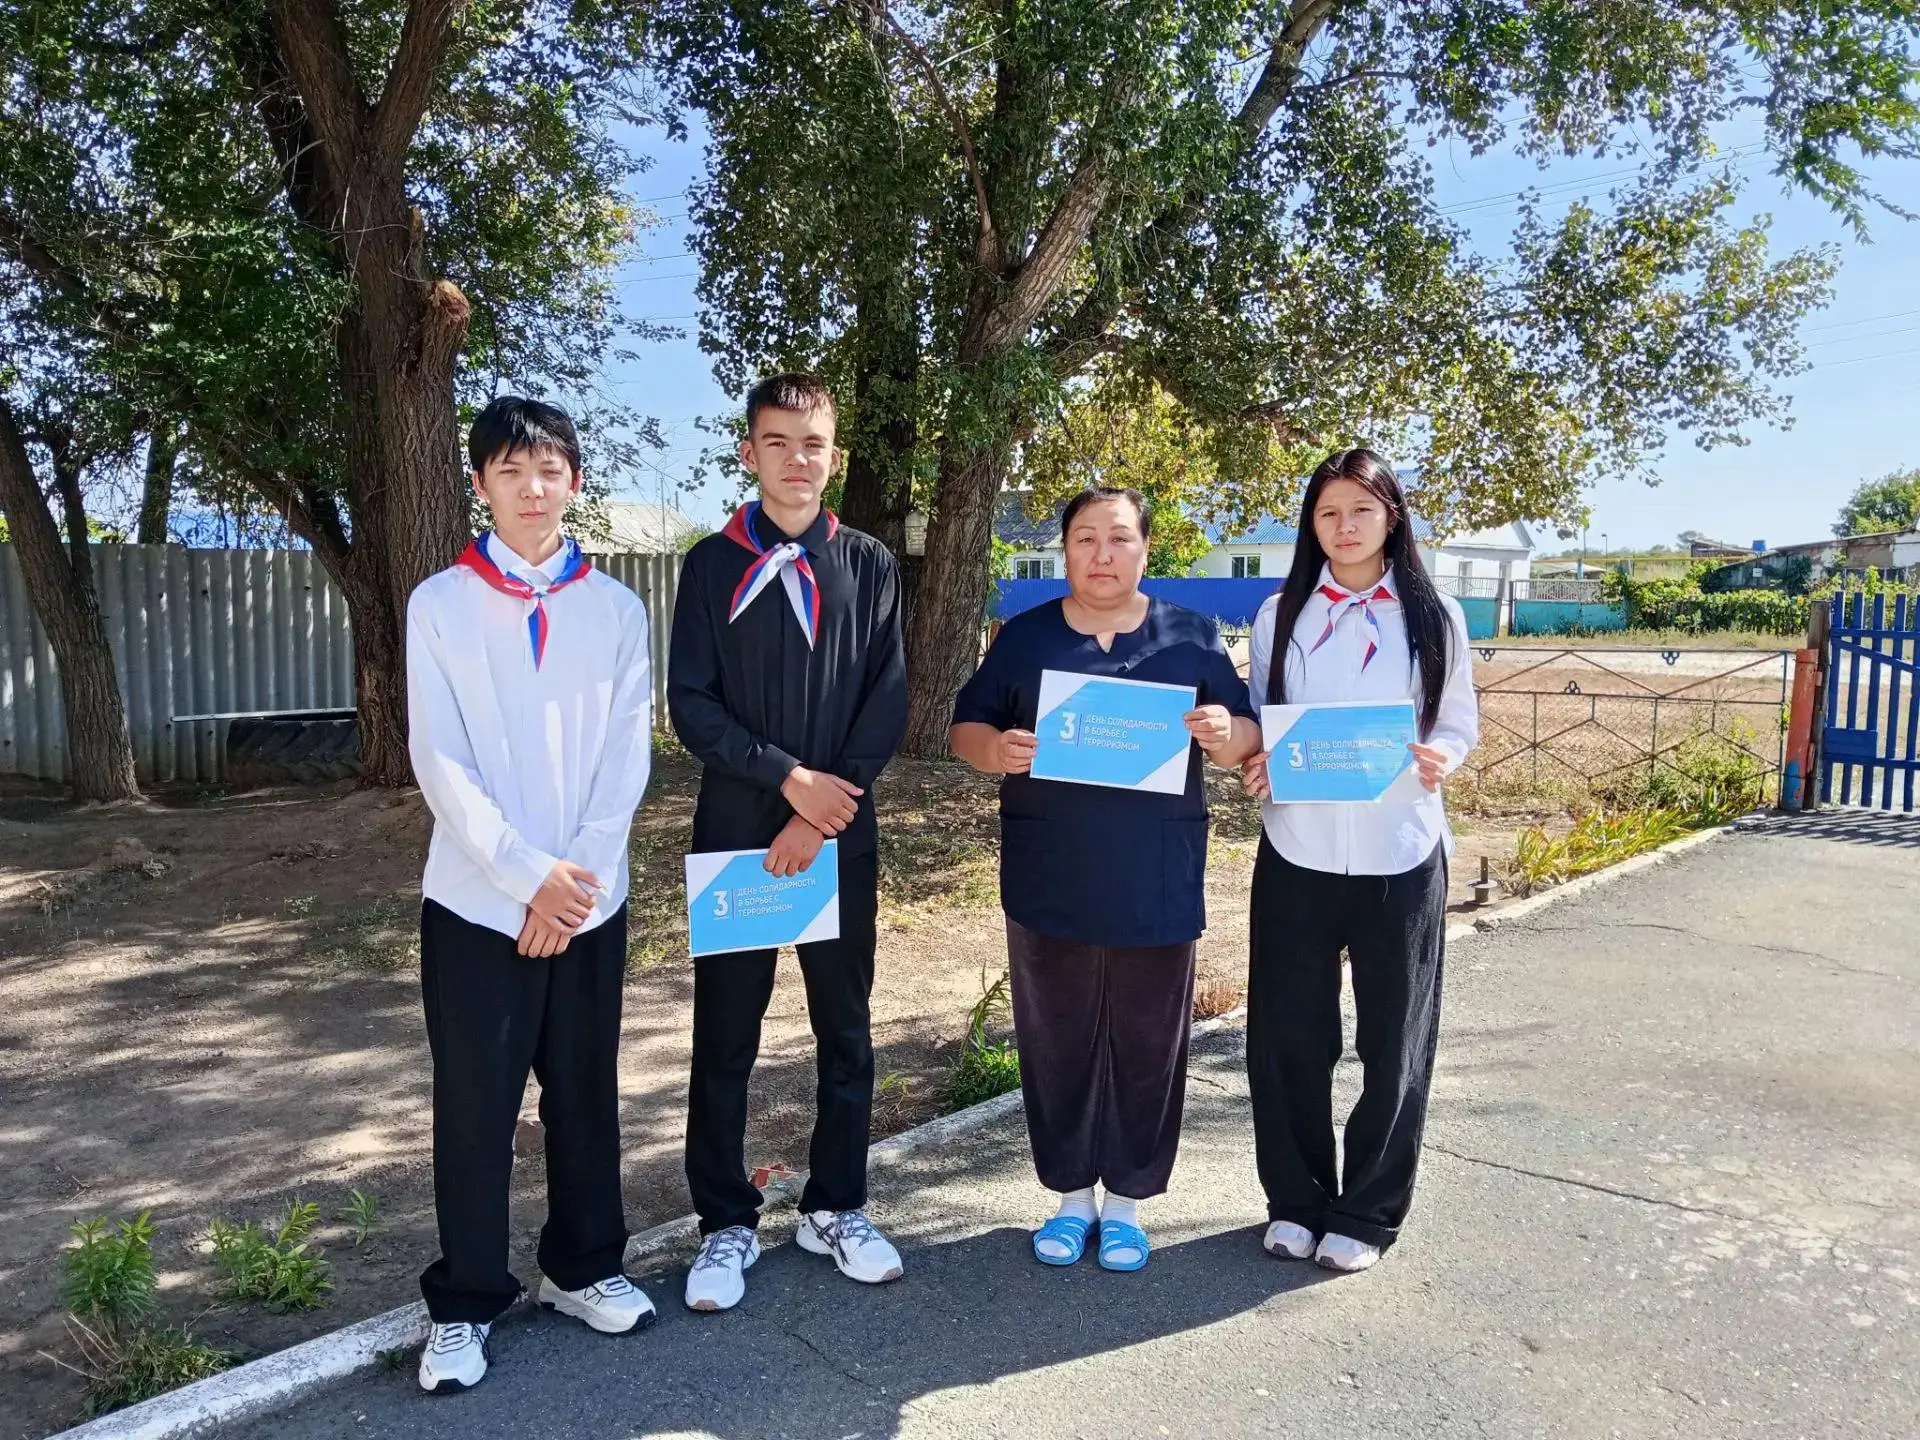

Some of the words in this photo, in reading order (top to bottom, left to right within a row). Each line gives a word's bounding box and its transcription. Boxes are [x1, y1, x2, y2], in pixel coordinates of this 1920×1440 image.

[1060, 711, 1076, 739] 3
[1085, 714, 1106, 724] ДЕНЬ
[1107, 717, 1168, 731] СОЛИДАРНОСТИ
[1092, 727, 1120, 737] БОРЬБЕ
[1122, 730, 1128, 739] С
[1084, 738, 1140, 752] ТЕРРОРИЗМОМ
[1311, 741, 1331, 749] ДЕНЬ
[1288, 742, 1304, 768] 3
[1318, 752, 1347, 760] БОРЬБЕ
[737, 888, 758, 896] ДЕНЬ
[759, 878, 816, 893] СОЛИДАРНОСТИ
[713, 890, 728, 917] 3
[738, 899, 743, 907] В
[745, 896, 773, 905] БОРЬБЕ
[774, 894, 780, 902] С
[738, 904, 793, 916] ТЕРРОРИЗМОМ
